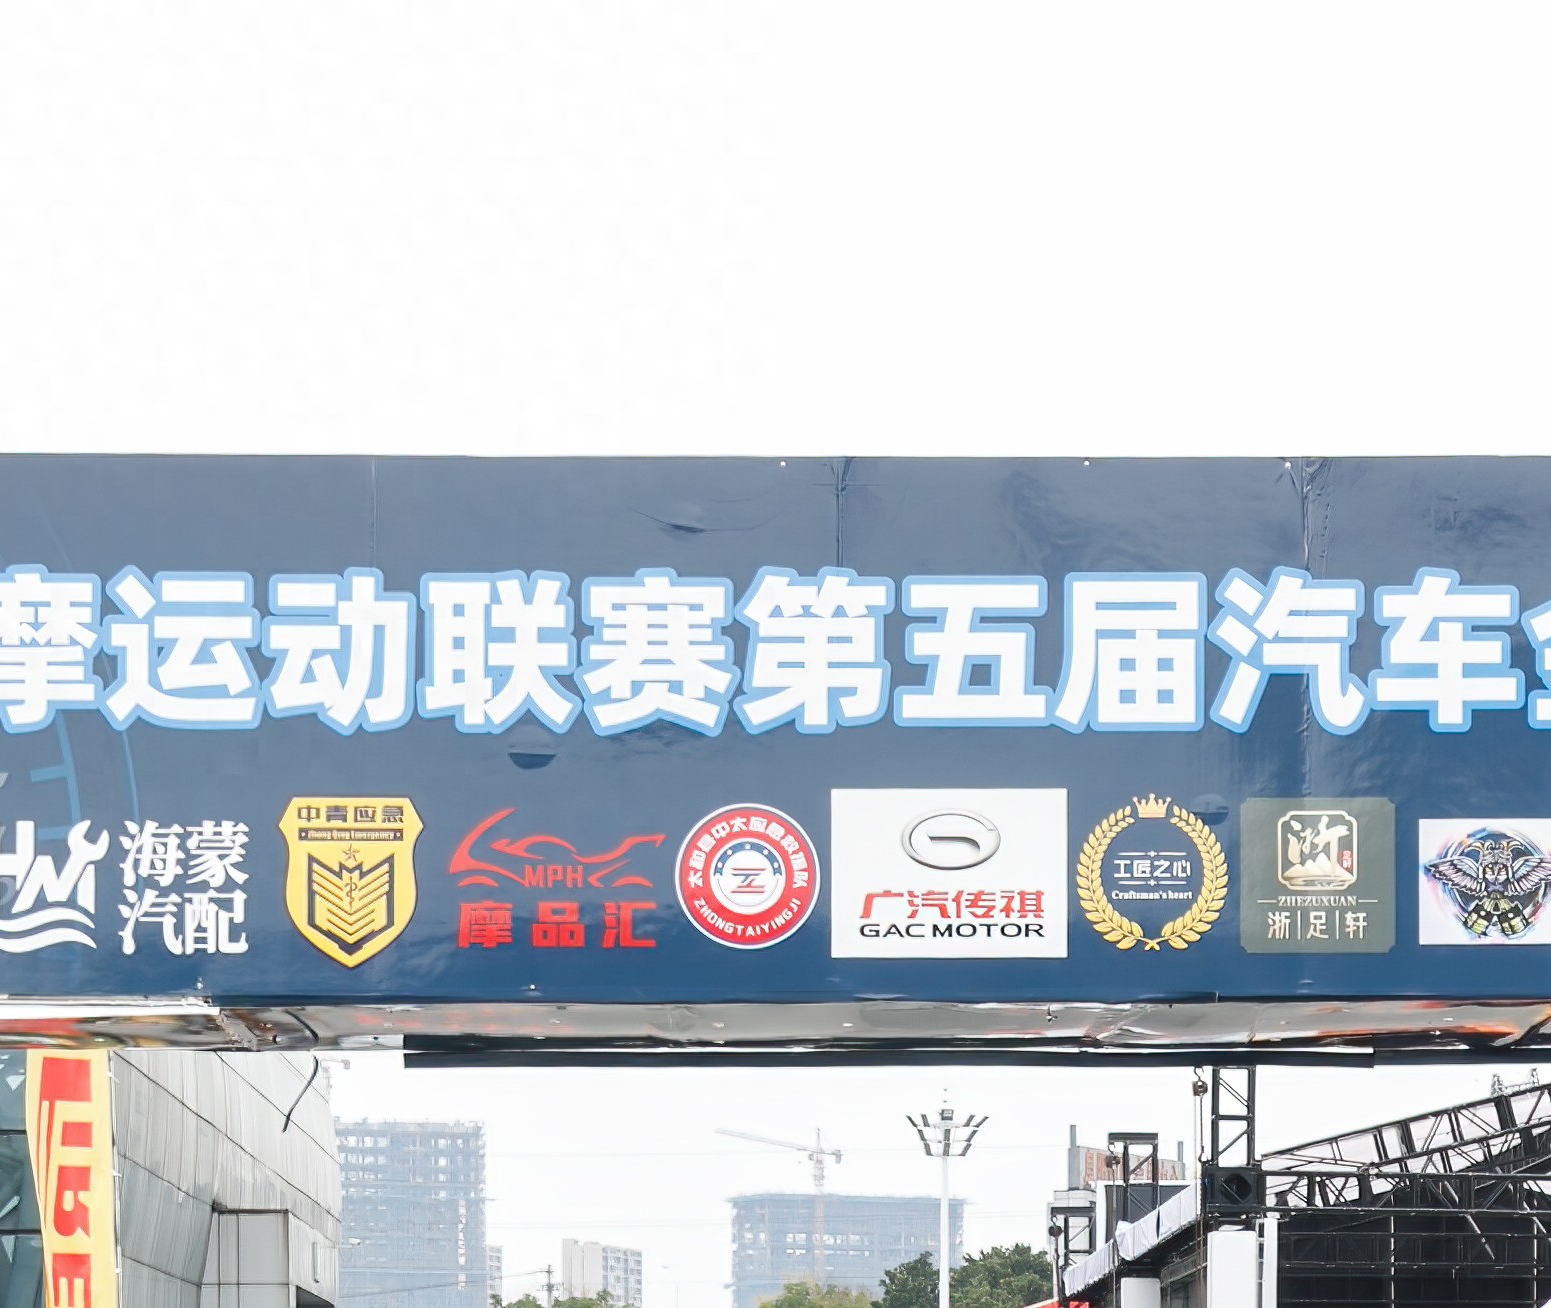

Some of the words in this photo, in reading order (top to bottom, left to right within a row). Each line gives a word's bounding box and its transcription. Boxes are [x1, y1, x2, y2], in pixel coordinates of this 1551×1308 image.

[297, 806, 404, 824] 中青应急
[119, 820, 250, 888] 海蒙
[1112, 857, 1192, 878] 工匠之心
[523, 864, 585, 888] MPH
[859, 889, 1046, 920] 广汽传祺
[1277, 895, 1358, 907] ZHEZUXUAN
[119, 888, 250, 956] 汽配
[457, 901, 656, 949] 摩品汇
[694, 897, 802, 937] ZHONGTAIYINGJI
[859, 922, 925, 939] GAC
[932, 922, 1045, 939] MOTOR
